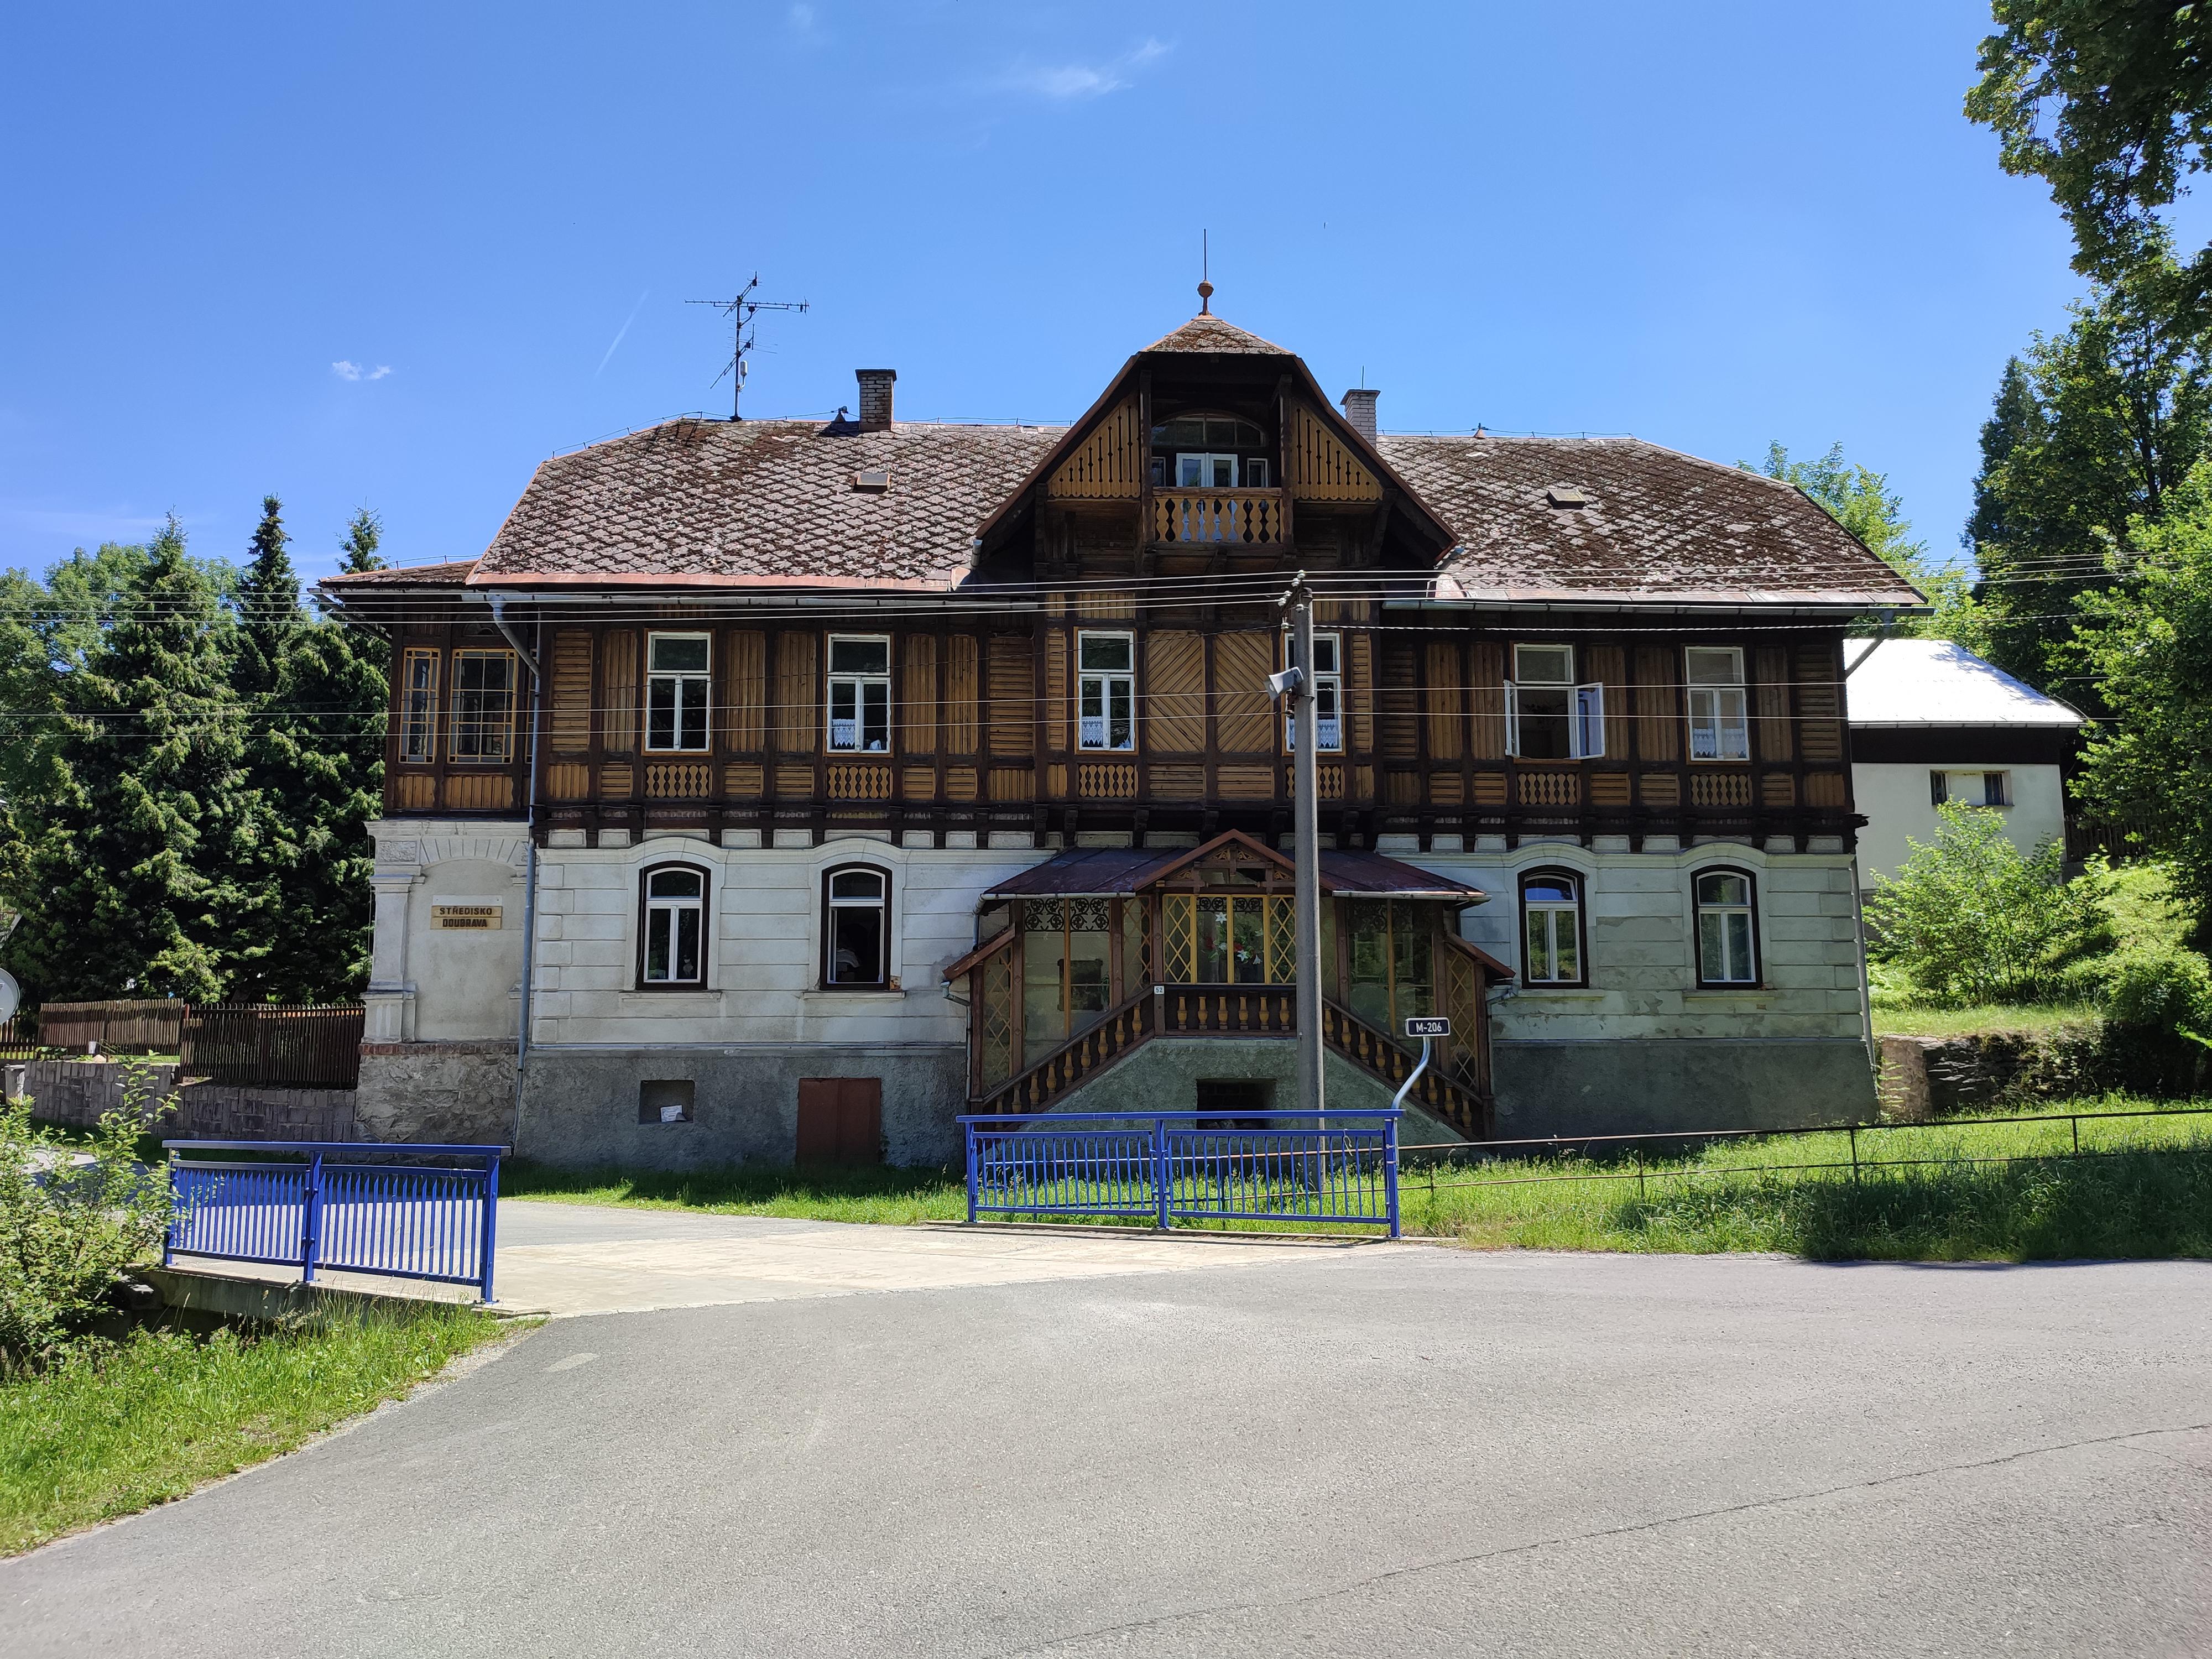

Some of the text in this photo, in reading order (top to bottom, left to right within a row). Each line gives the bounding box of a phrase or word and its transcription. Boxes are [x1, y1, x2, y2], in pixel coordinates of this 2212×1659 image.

[440, 906, 492, 915] STŘEDISKO
[442, 919, 487, 927] DOUBRAVA
[1416, 1022, 1442, 1032] M-206
